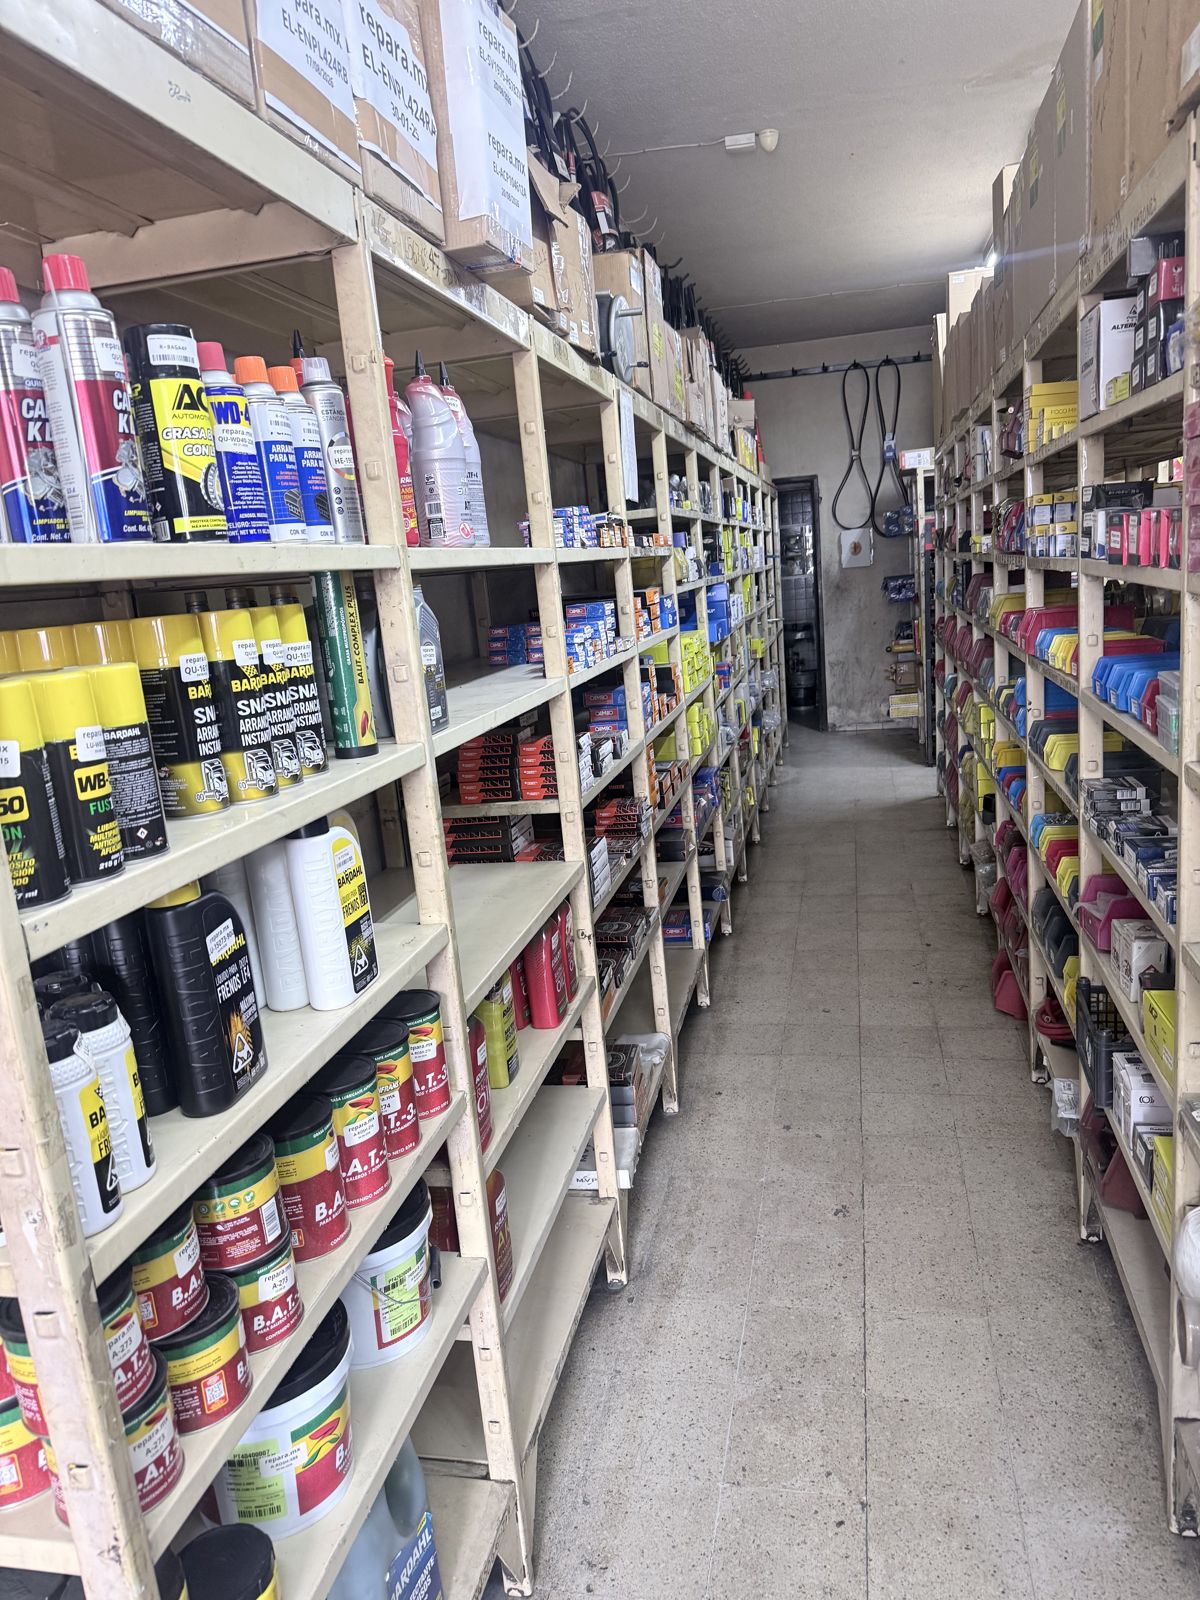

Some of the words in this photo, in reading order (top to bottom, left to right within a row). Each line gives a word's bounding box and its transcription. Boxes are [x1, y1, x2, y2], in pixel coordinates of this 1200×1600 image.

[477, 19, 519, 77] repara.mx
[487, 131, 526, 177] repara.mx
[161, 427, 206, 440] GRASA
[183, 444, 206, 456] CON
[269, 453, 288, 462] PARA
[344, 585, 354, 611] PLUS
[349, 611, 362, 657] COMPLEX
[353, 656, 365, 685] BALIT.
[104, 727, 141, 741] BARDAHL
[337, 864, 363, 889] BARDAHL
[341, 897, 360, 920] FRENOS
[216, 974, 242, 1004] FRENOS
[348, 1116, 375, 1132] repara.mx
[272, 1276, 289, 1291] A-273
[265, 1322, 291, 1341] CONTENIDO
[111, 1337, 133, 1360] A-273
[264, 1447, 301, 1464] repara.mx
